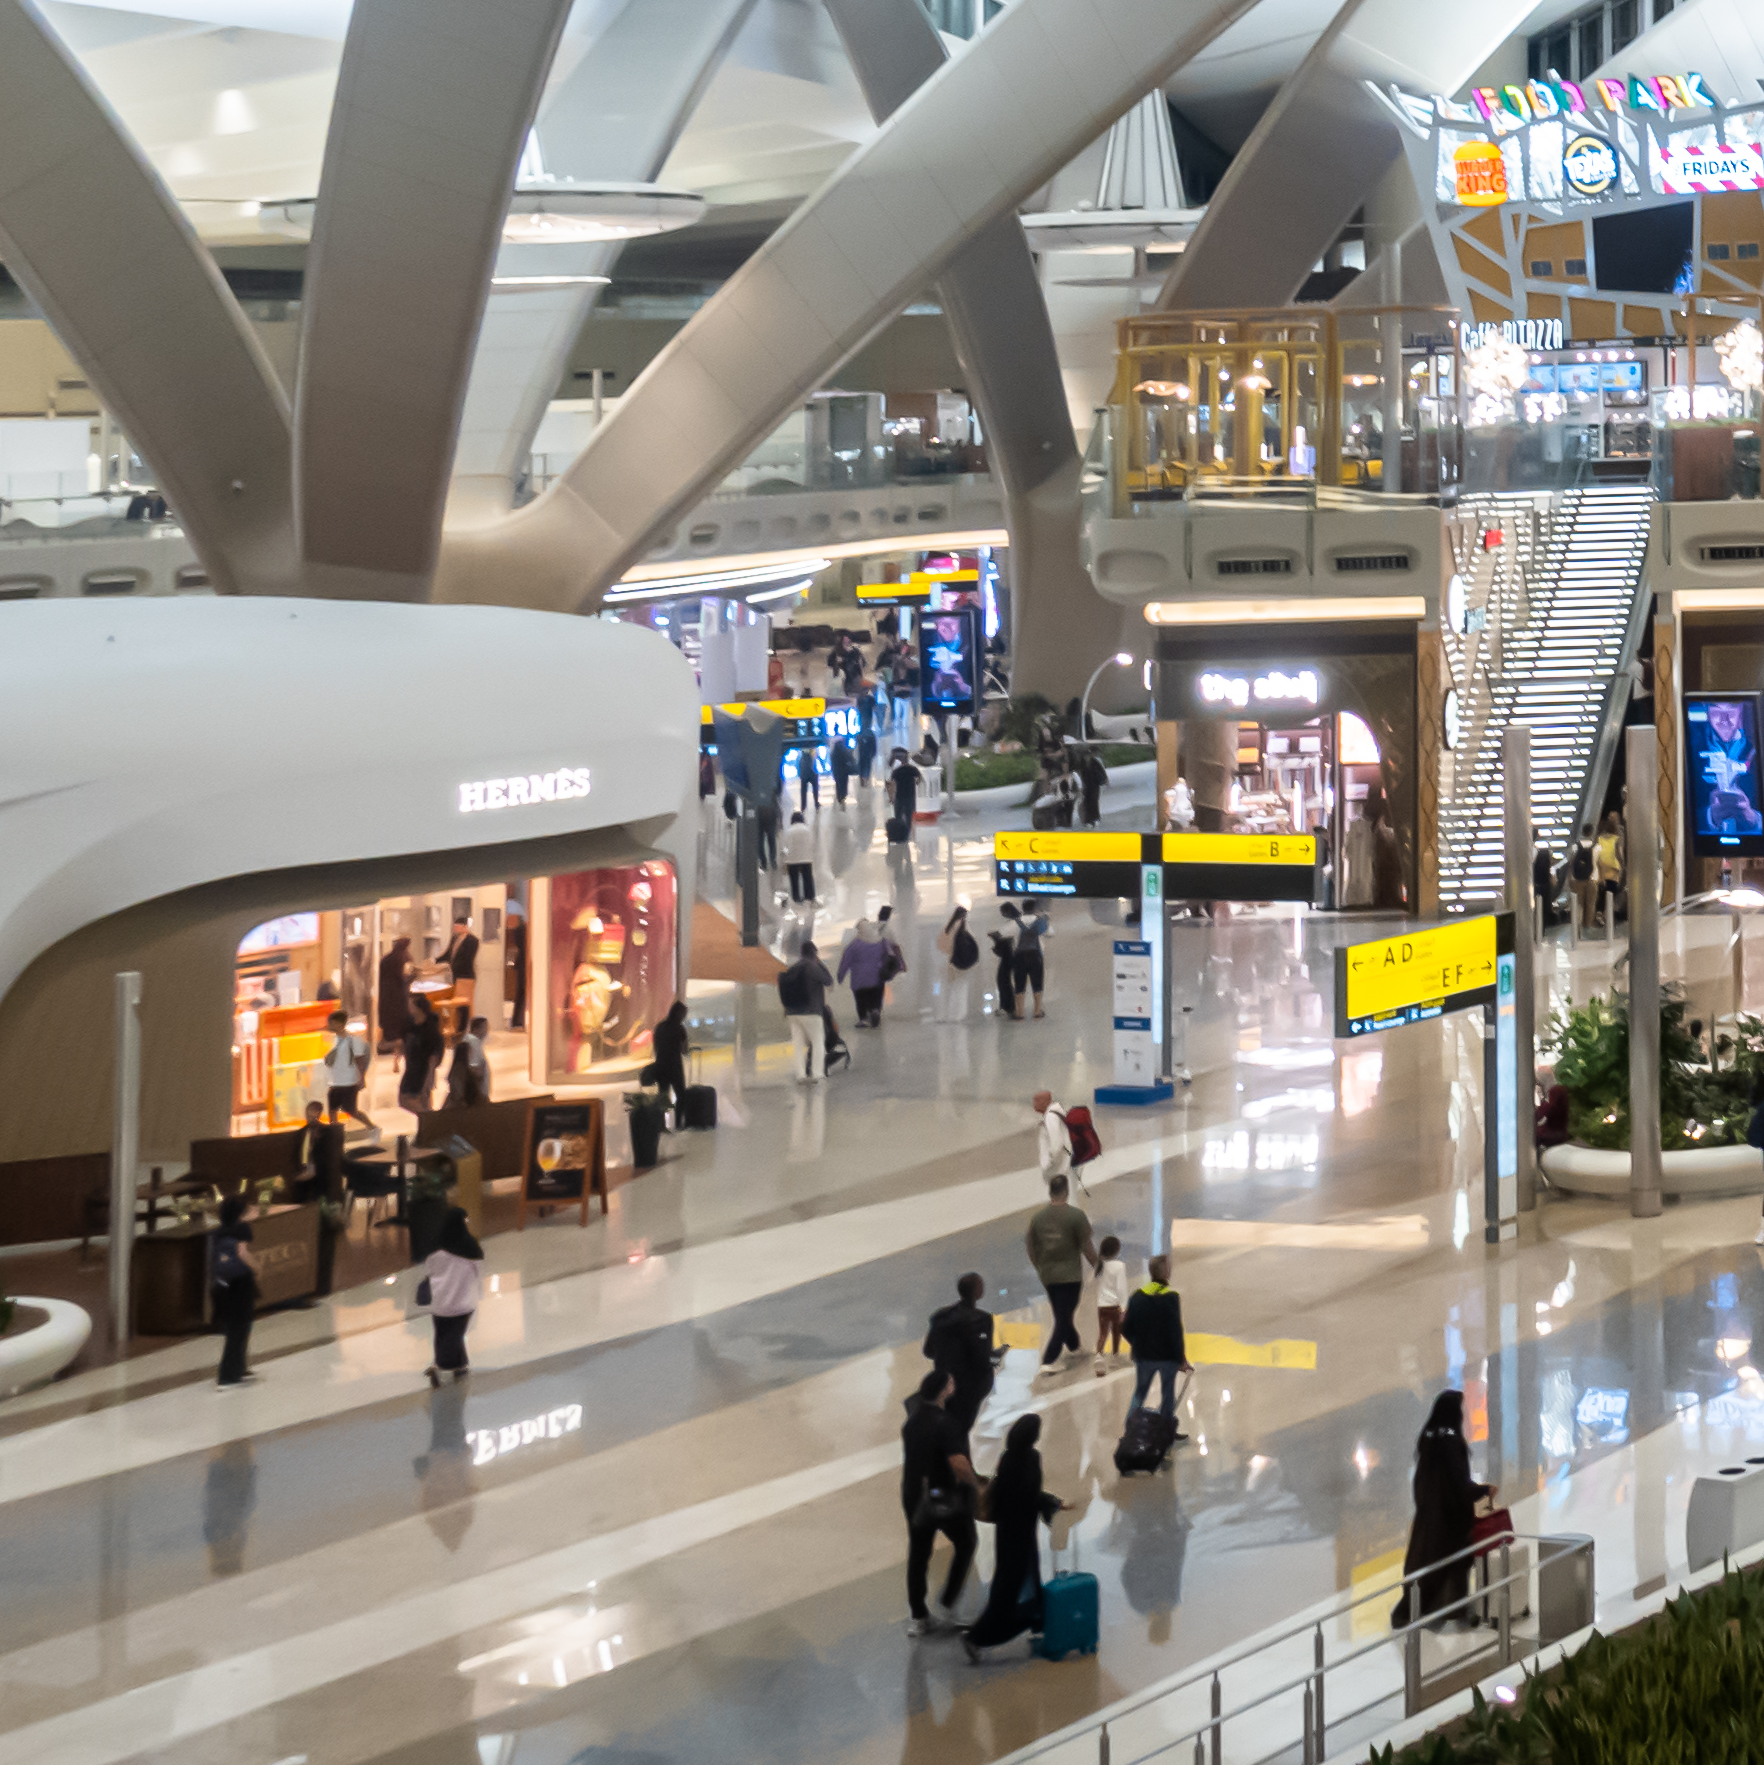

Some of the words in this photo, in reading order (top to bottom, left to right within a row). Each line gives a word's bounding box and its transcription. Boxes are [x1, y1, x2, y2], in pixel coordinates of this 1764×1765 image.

[1472, 79, 1586, 122] FOOD
[1597, 73, 1714, 112] PARK
[1683, 159, 1750, 176] FRIDAYS
[1457, 173, 1506, 194] KING
[1029, 838, 1039, 854] C
[1270, 841, 1280, 857] B
[1383, 946, 1395, 968] A
[1402, 942, 1413, 963] D
[1442, 967, 1450, 988] E
[1456, 963, 1464, 985] F
